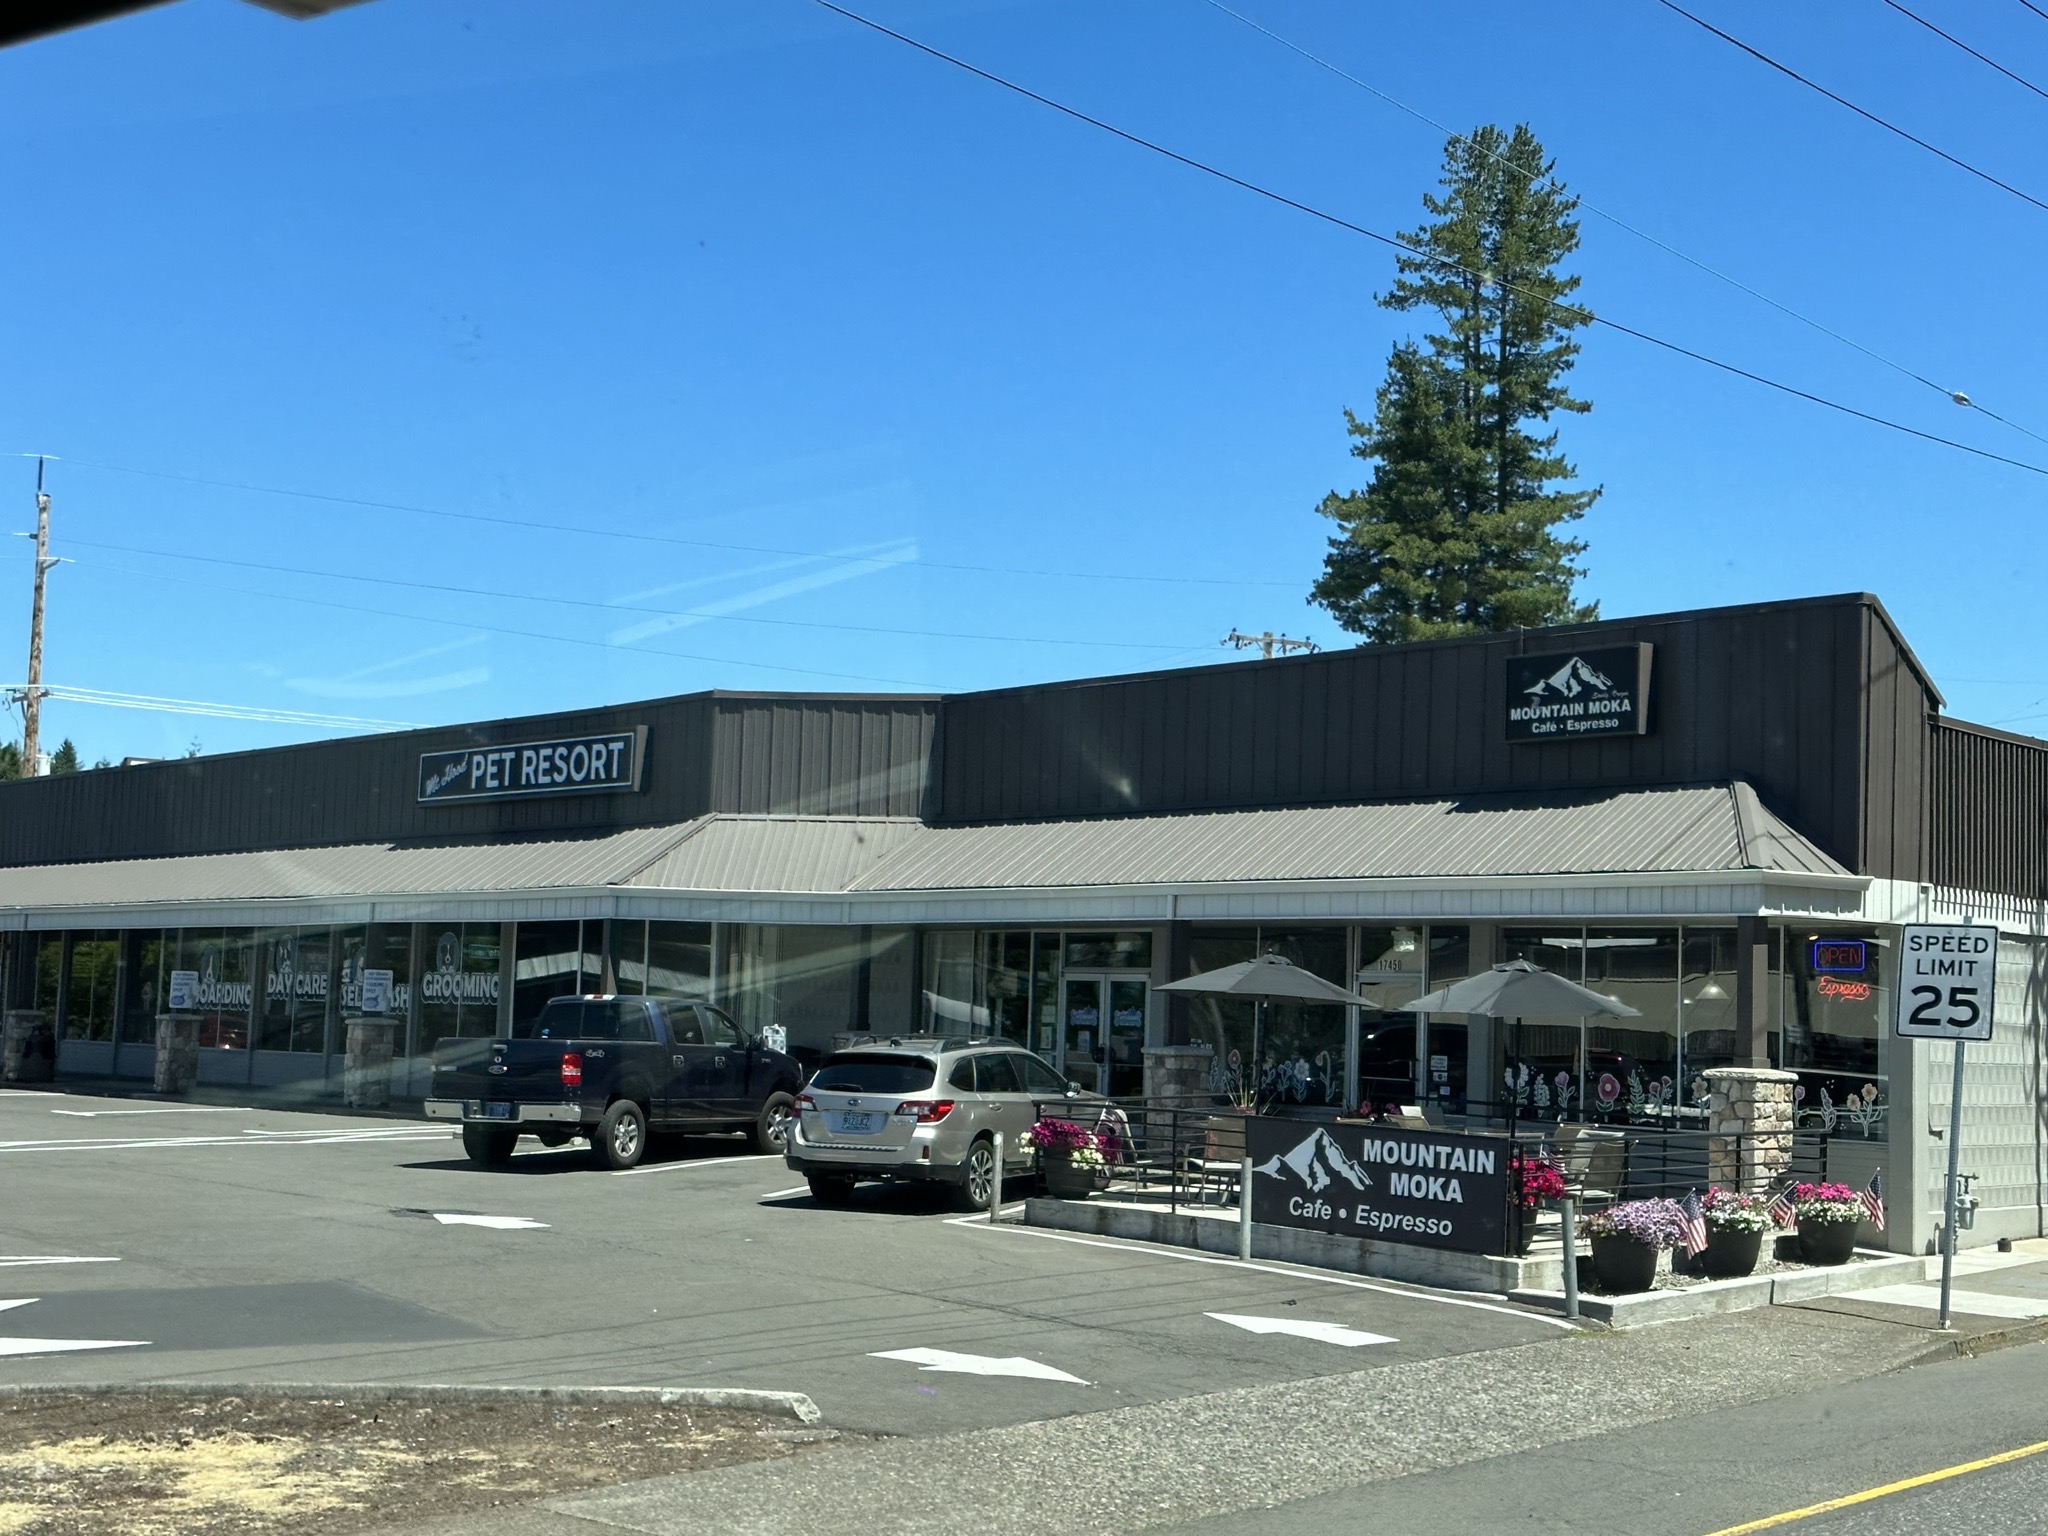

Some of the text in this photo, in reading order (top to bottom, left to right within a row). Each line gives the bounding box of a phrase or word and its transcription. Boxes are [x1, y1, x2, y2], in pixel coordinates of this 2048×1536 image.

[1510, 698, 1631, 721] MOUNTAIN MOKA
[1567, 718, 1619, 732] Espresso
[471, 751, 516, 789] PET
[521, 741, 624, 785] RESORT
[1818, 947, 1862, 964] OPEN
[1909, 935, 1989, 954] SPEED
[1379, 959, 1402, 971] 17450
[1916, 958, 1978, 977] LIMIT
[197, 984, 251, 1005] OARDING
[268, 973, 328, 995] DAY CARE
[423, 974, 498, 998] GROOMING
[1817, 976, 1870, 1002] Espresso
[341, 985, 362, 1007] SEL
[1908, 985, 1980, 1028] 25
[1363, 1139, 1495, 1175] MOUNTAIN
[1390, 1172, 1463, 1203] MOKA
[1355, 1204, 1453, 1236] Espresso
